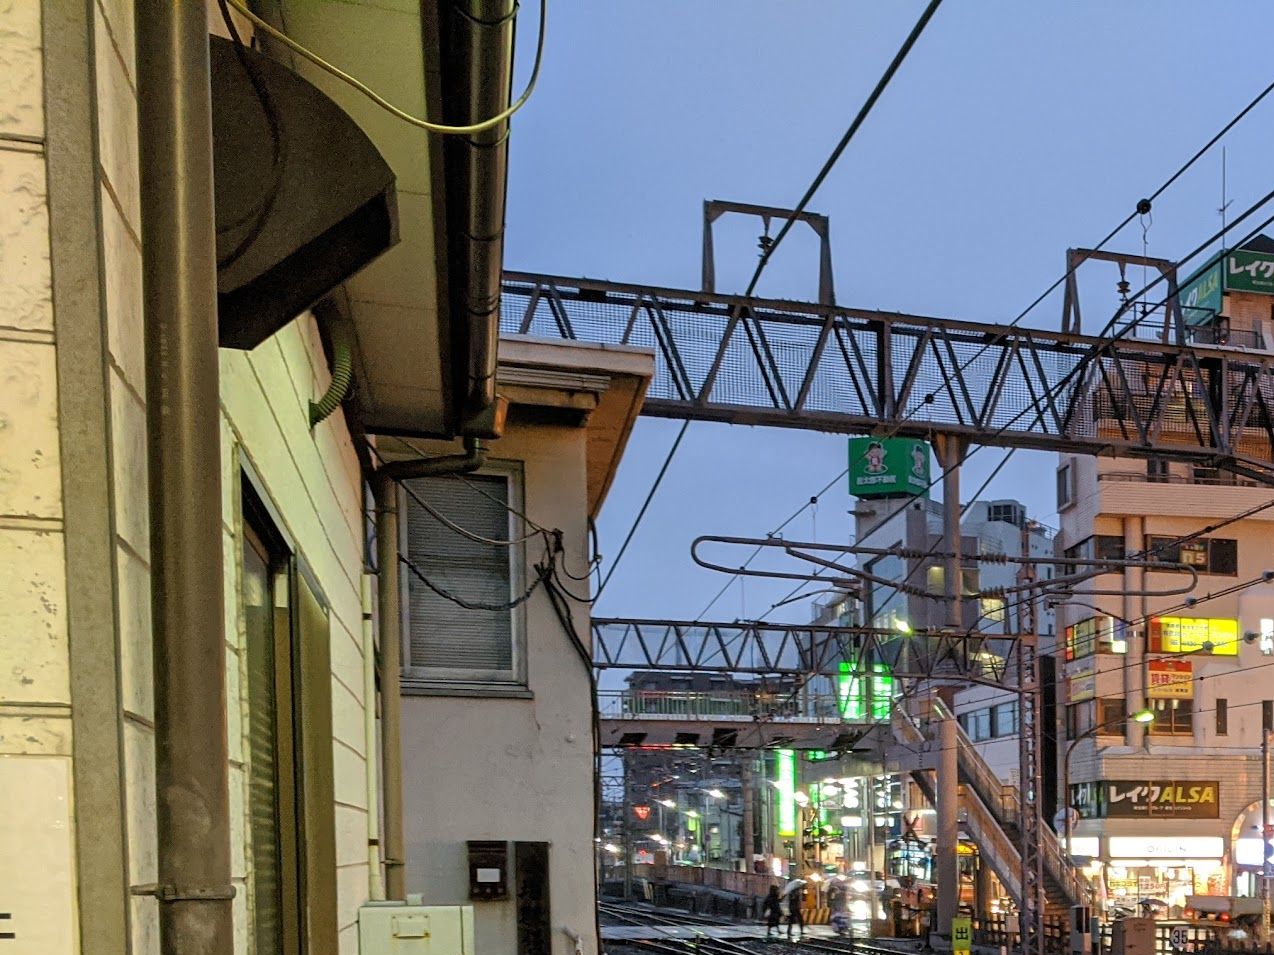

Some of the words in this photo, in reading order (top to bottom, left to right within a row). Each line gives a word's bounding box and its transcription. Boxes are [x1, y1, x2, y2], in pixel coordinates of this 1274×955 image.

[1109, 785, 1215, 803] レイクALSA
[955, 927, 969, 941] 出
[1173, 929, 1188, 944] 35
